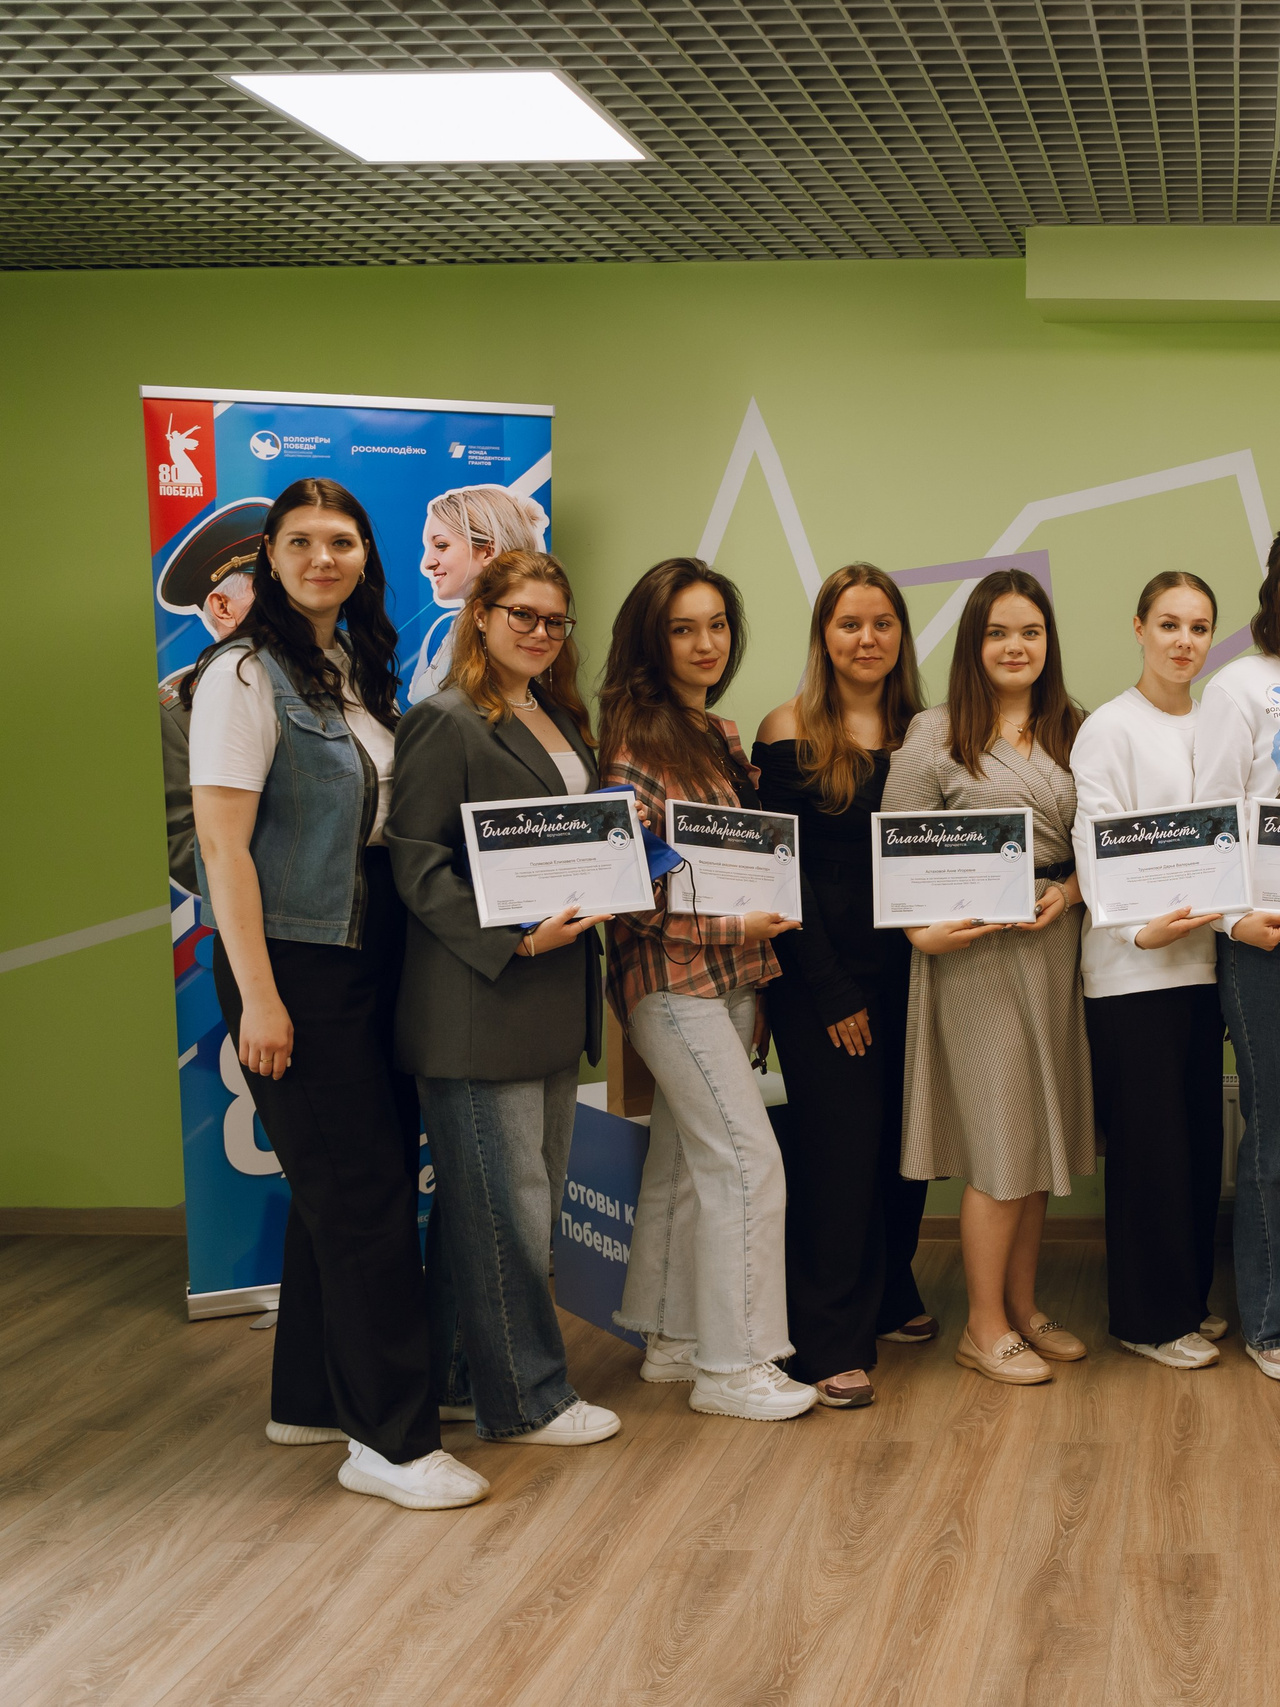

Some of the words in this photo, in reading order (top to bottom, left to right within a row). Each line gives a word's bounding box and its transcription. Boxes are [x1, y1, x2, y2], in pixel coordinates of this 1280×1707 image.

[283, 436, 331, 444] ВОЛОНТЁРЫ
[351, 445, 427, 456] росмолодёжь
[158, 463, 179, 483] 80
[159, 485, 204, 498] ПОБЕДА!
[480, 818, 590, 838] Благодарность
[677, 815, 763, 840] Благодарность
[886, 828, 986, 847] Благодарность
[1100, 825, 1198, 847] Благодарность
[563, 1173, 620, 1221] отовы
[624, 1203, 635, 1227] к
